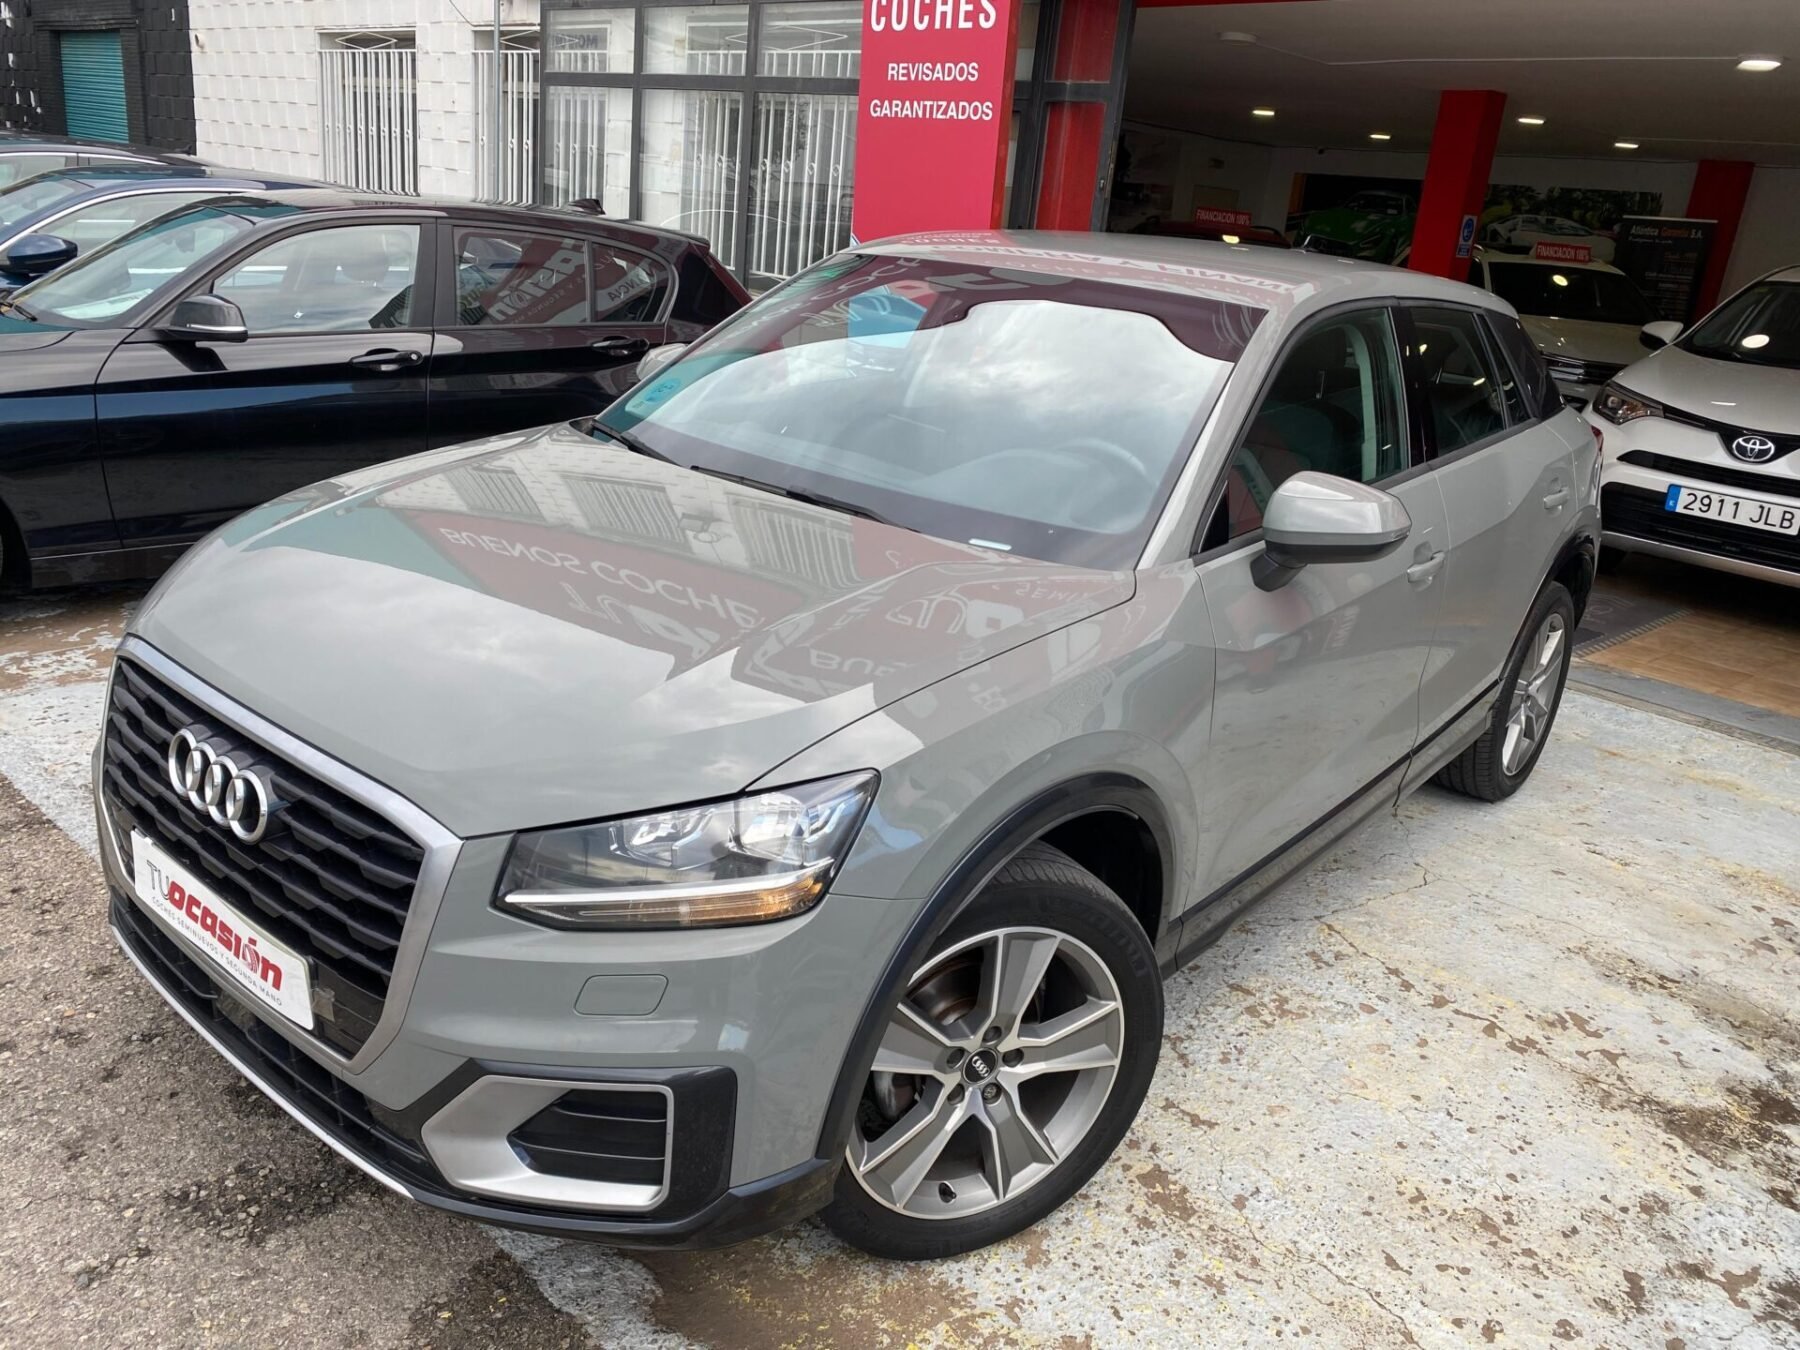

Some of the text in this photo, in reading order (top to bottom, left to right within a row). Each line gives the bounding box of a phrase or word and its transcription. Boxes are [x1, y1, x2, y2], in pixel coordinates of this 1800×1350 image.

[870, 0, 997, 32] COCHES
[887, 62, 979, 82] REVISADOS
[869, 99, 993, 121] GARANTIZADOS
[1682, 492, 1795, 530] 2911 JLB
[225, 955, 258, 989] SEGUNDA
[258, 985, 283, 1006] MANO
